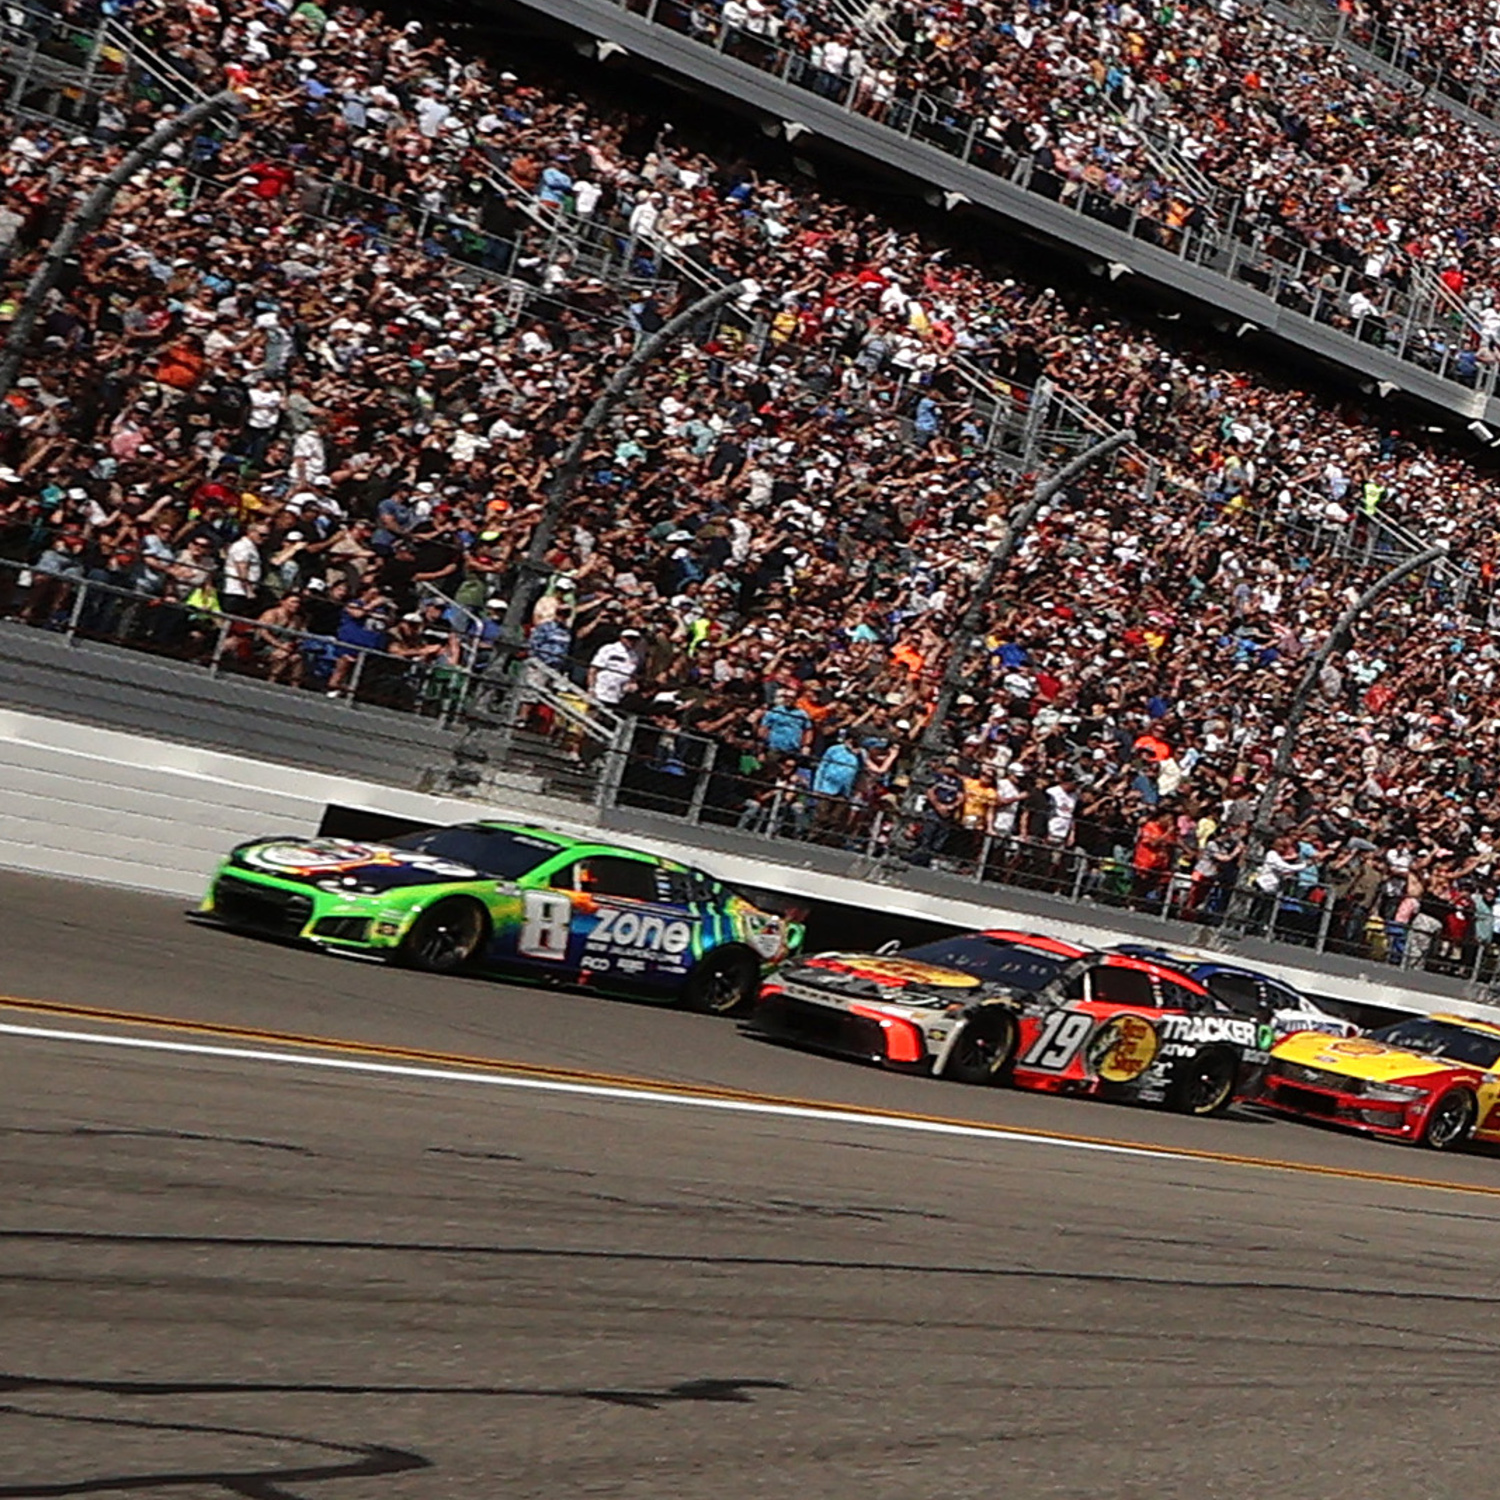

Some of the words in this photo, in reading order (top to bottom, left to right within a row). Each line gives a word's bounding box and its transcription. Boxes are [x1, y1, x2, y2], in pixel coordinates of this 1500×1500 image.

[520, 890, 571, 960] 8
[587, 908, 691, 954] zone
[1024, 1010, 1094, 1069] 19
[1161, 1014, 1257, 1048] TRACKER
